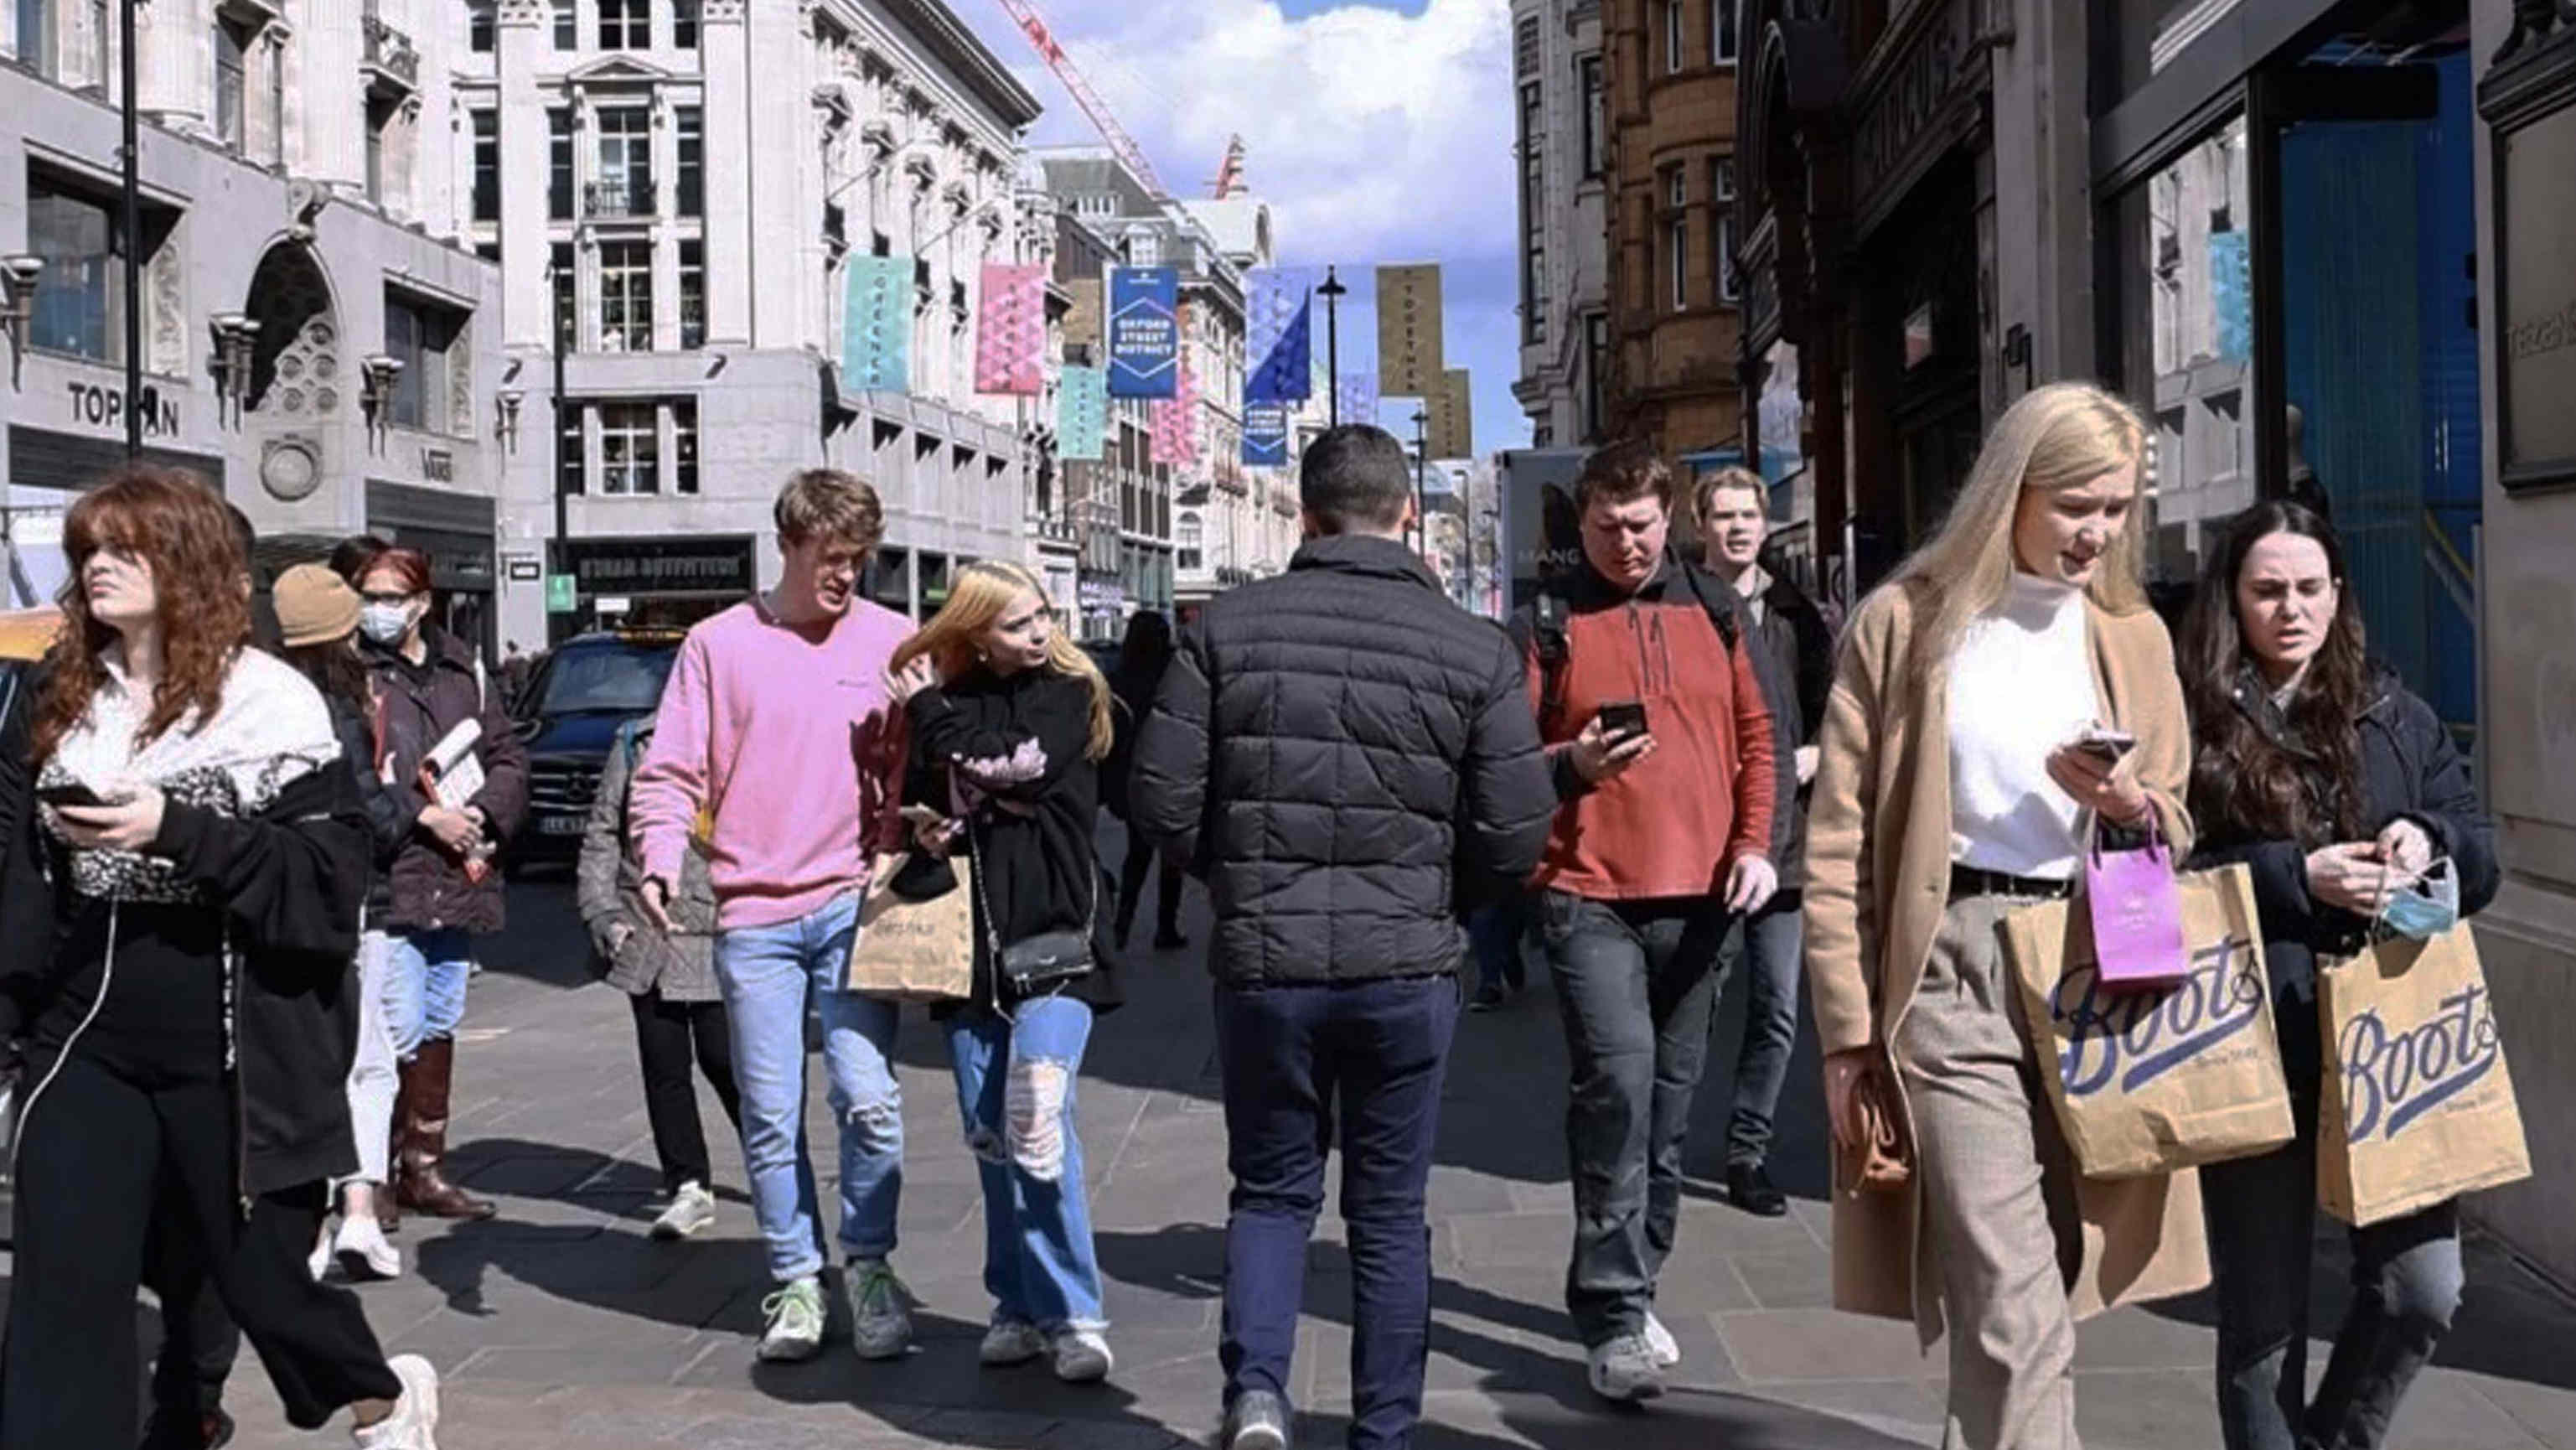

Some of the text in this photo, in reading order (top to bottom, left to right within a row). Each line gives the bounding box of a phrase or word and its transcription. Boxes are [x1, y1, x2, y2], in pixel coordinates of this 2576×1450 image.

[1117, 318, 1171, 329] OXFORD
[1120, 332, 1167, 342] STREET
[1115, 344, 1172, 355] DISTRICT
[2046, 934, 2263, 1095] Boots
[2337, 983, 2498, 1143] Boots
